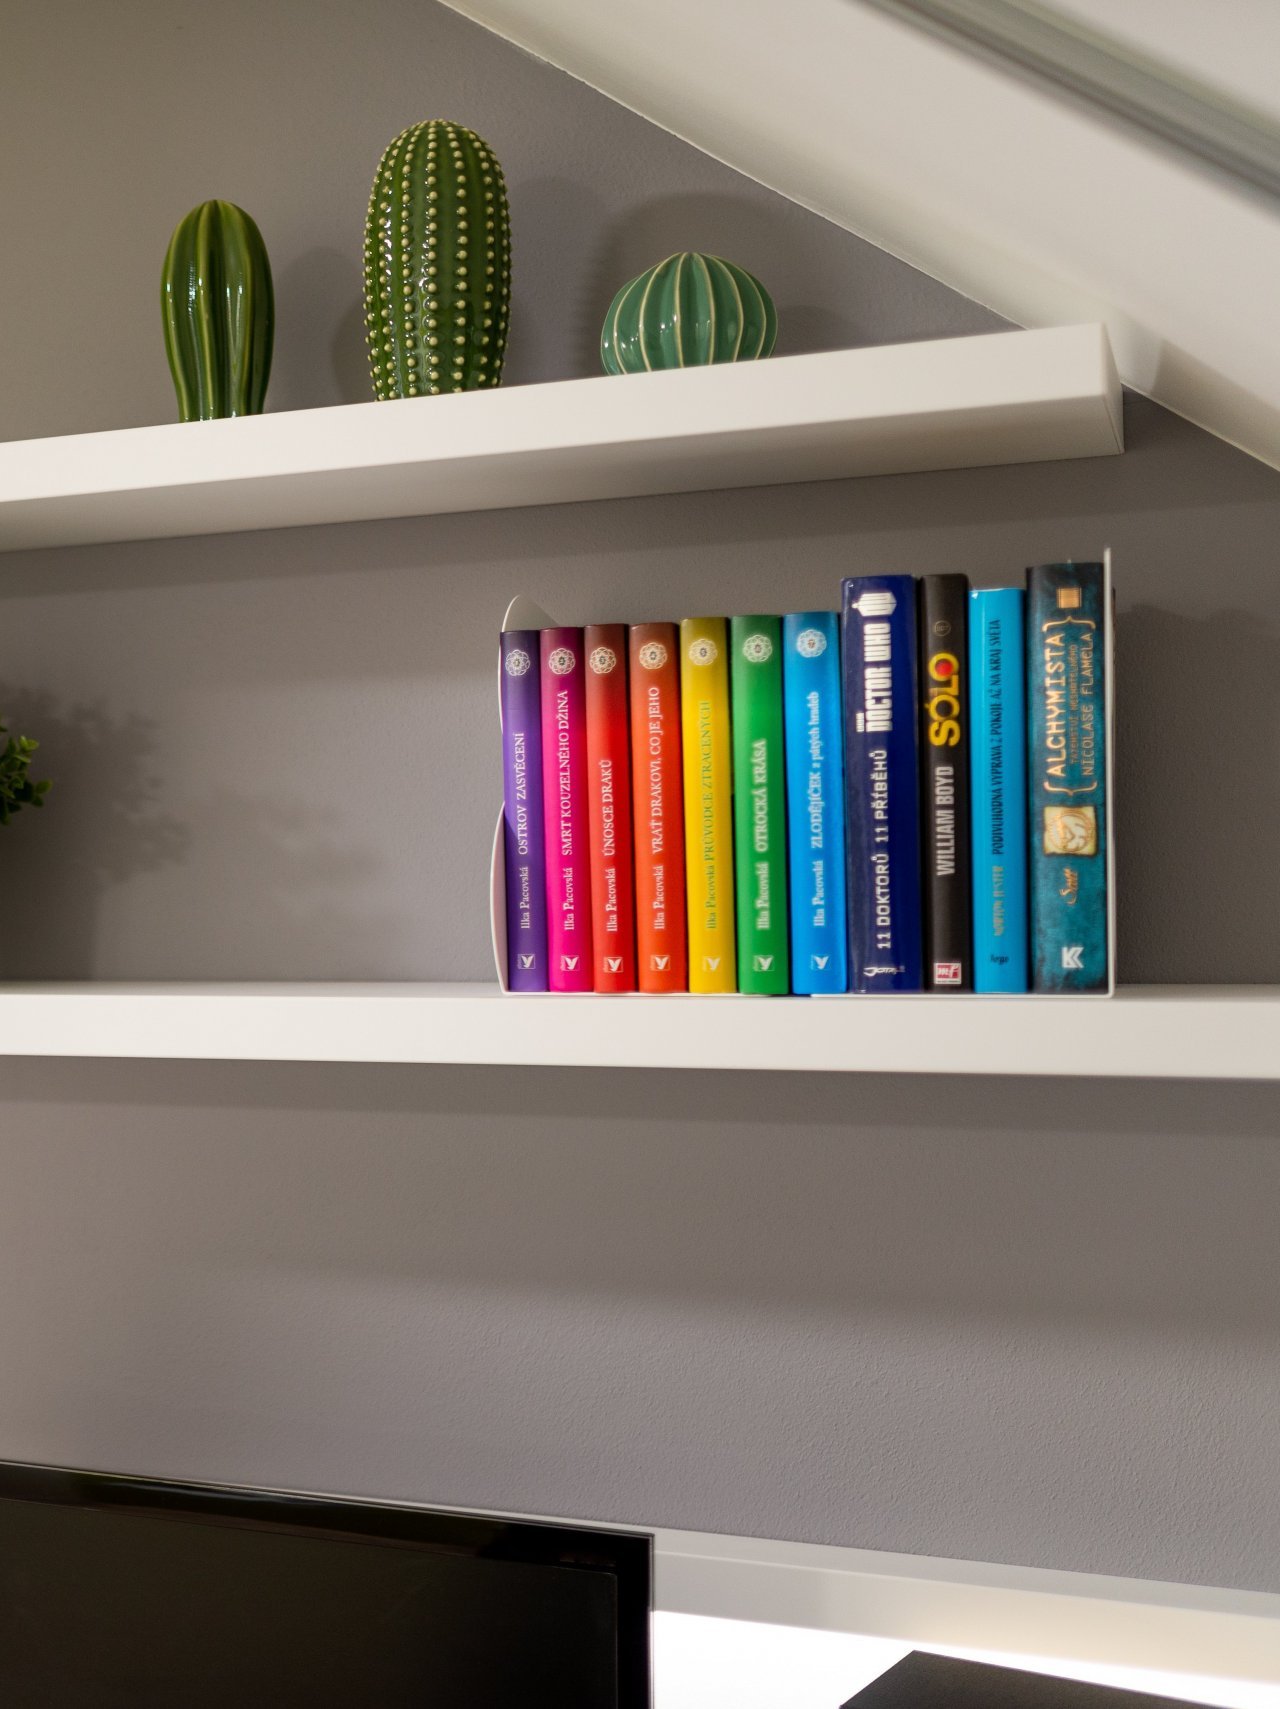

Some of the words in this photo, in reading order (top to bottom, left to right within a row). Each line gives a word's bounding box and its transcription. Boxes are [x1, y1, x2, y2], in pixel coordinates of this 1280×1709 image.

[863, 623, 891, 661] WHO
[990, 648, 1004, 671] KRAJ
[990, 673, 1001, 686] NA
[1080, 633, 1094, 695] FLAMELA
[556, 691, 569, 729] DŽINA
[648, 687, 662, 719] JEHO
[864, 667, 892, 732] DOCTOR
[990, 702, 1003, 736] POKOJE
[1045, 633, 1066, 777] ALCHYMISTA
[649, 722, 662, 736] JE
[650, 738, 661, 755] CO
[1081, 704, 1094, 775] NICOLASE
[514, 733, 527, 800] ZASVĚCENÍ
[557, 732, 571, 818] KOUZELNÉHO
[600, 759, 613, 803] DRAKŮ
[752, 740, 766, 784] KRÁSA
[990, 745, 1004, 786] VÝPRAVA
[870, 750, 888, 819] PŘÍBĚHŮ
[934, 766, 954, 805] BOYD
[517, 806, 528, 855] OSTROV
[602, 805, 615, 856] ÚNOSCE
[700, 792, 714, 861] PRŮVODCE
[753, 788, 768, 852] OTROCKÁ
[808, 771, 824, 848] ZLODĚJÍČEK
[560, 820, 572, 856] SMRT
[875, 828, 889, 843] 11
[936, 810, 954, 875] WILLIAM
[518, 867, 530, 909] Pacovská
[563, 867, 574, 910] Pacovská
[605, 868, 617, 911] Pacovská
[652, 866, 665, 909] Pacovská
[704, 865, 715, 908] Pacovská
[756, 862, 769, 908] Pacovská
[812, 861, 825, 905] Pacovská
[872, 853, 890, 925] DOKTORŮ
[520, 912, 530, 929] Ilka
[564, 913, 575, 930] Ilka
[607, 914, 617, 931] Ilka
[655, 912, 665, 929] Ilka
[706, 912, 716, 929] Ilka
[758, 911, 769, 929] Ilka
[813, 908, 825, 926] Ilka
[877, 935, 891, 949] 11
